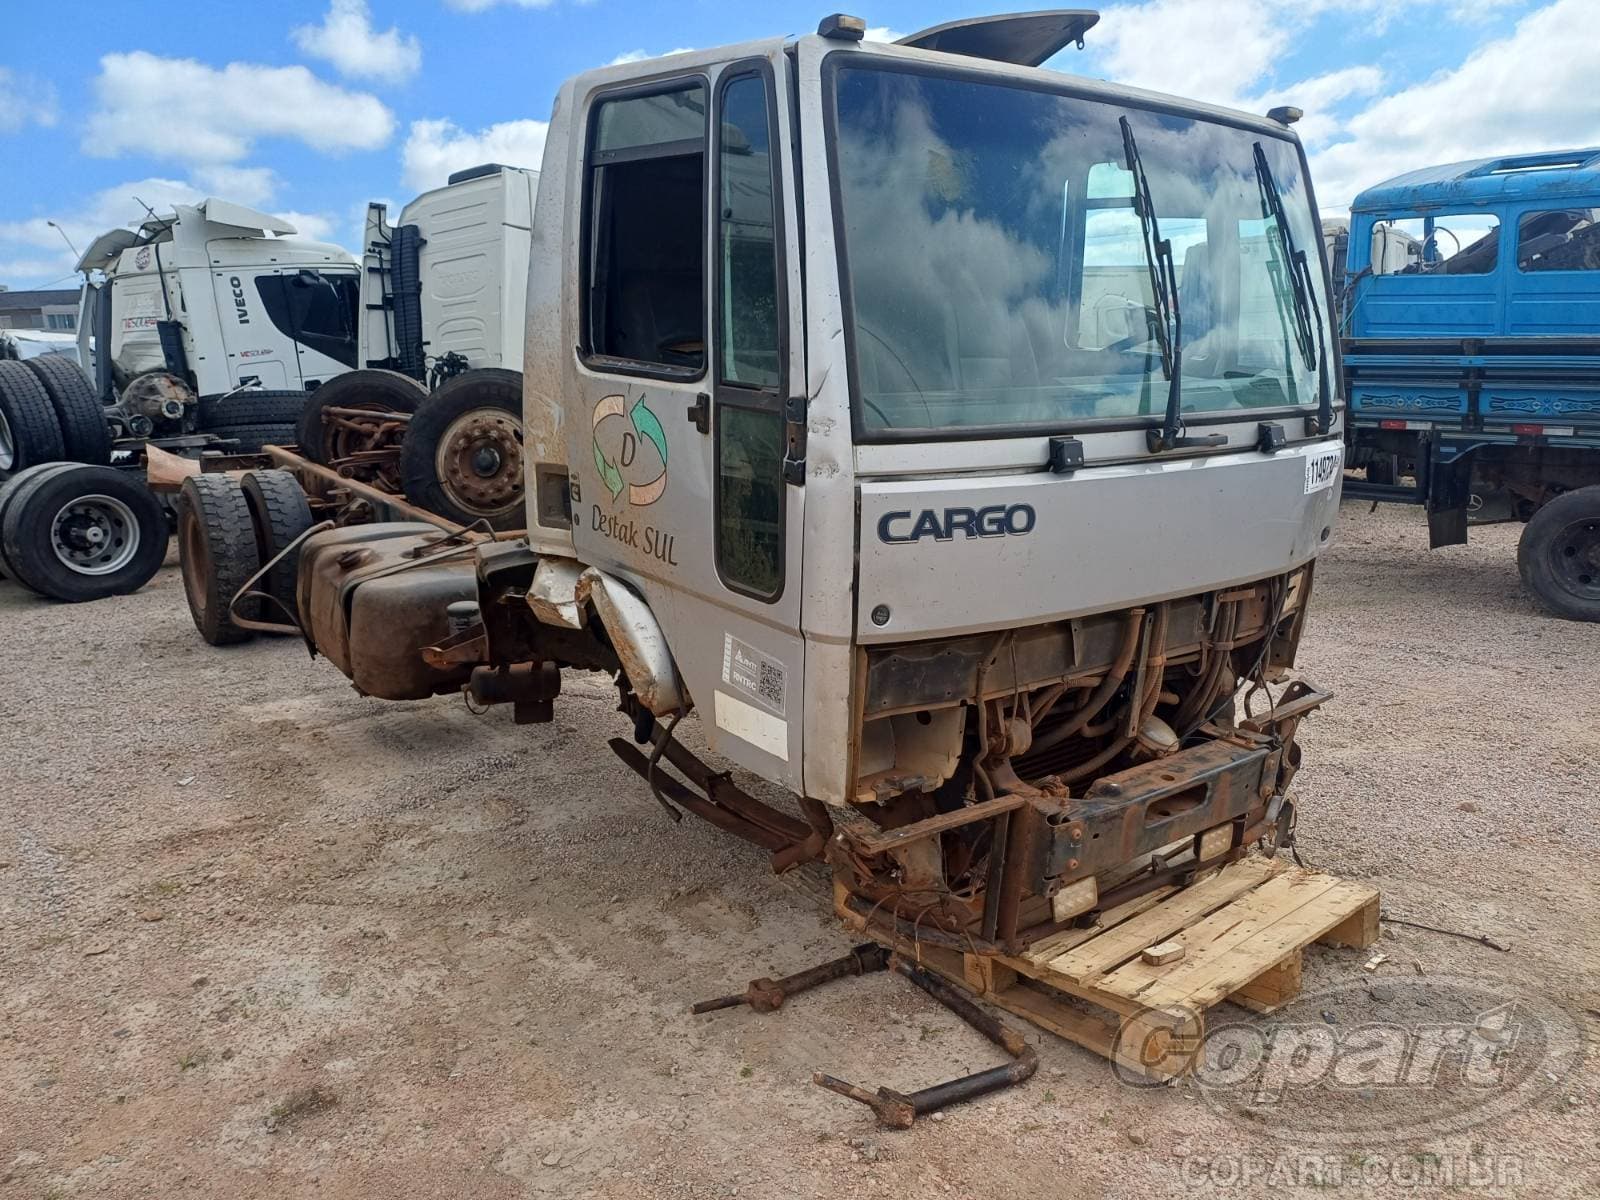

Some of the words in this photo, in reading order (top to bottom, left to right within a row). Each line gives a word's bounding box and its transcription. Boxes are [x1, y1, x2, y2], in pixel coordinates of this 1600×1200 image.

[230, 276, 250, 324] IVECO
[592, 504, 638, 548] Destak
[642, 526, 678, 567] SUL
[877, 503, 1036, 545] CARGO
